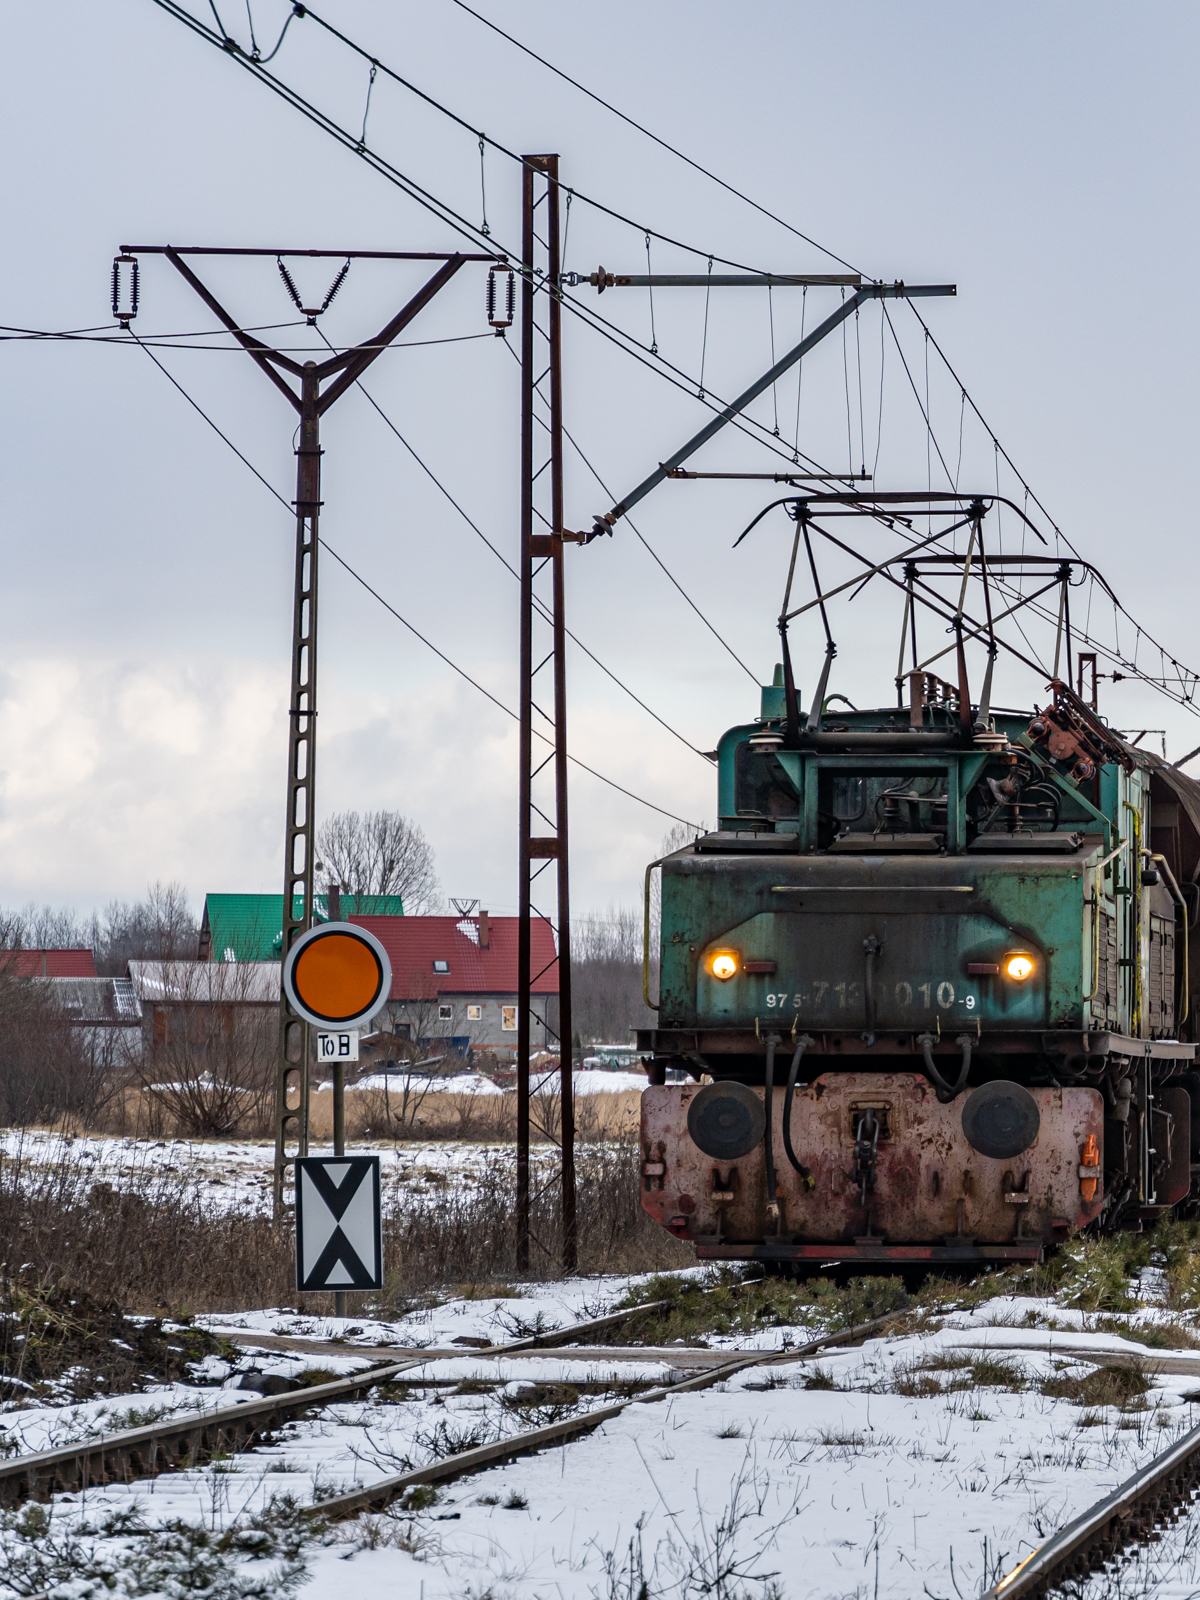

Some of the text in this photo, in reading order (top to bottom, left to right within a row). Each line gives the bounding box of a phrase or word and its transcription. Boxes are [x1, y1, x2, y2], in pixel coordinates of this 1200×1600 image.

[766, 994, 788, 1008] 97
[318, 1034, 350, 1056] To B
